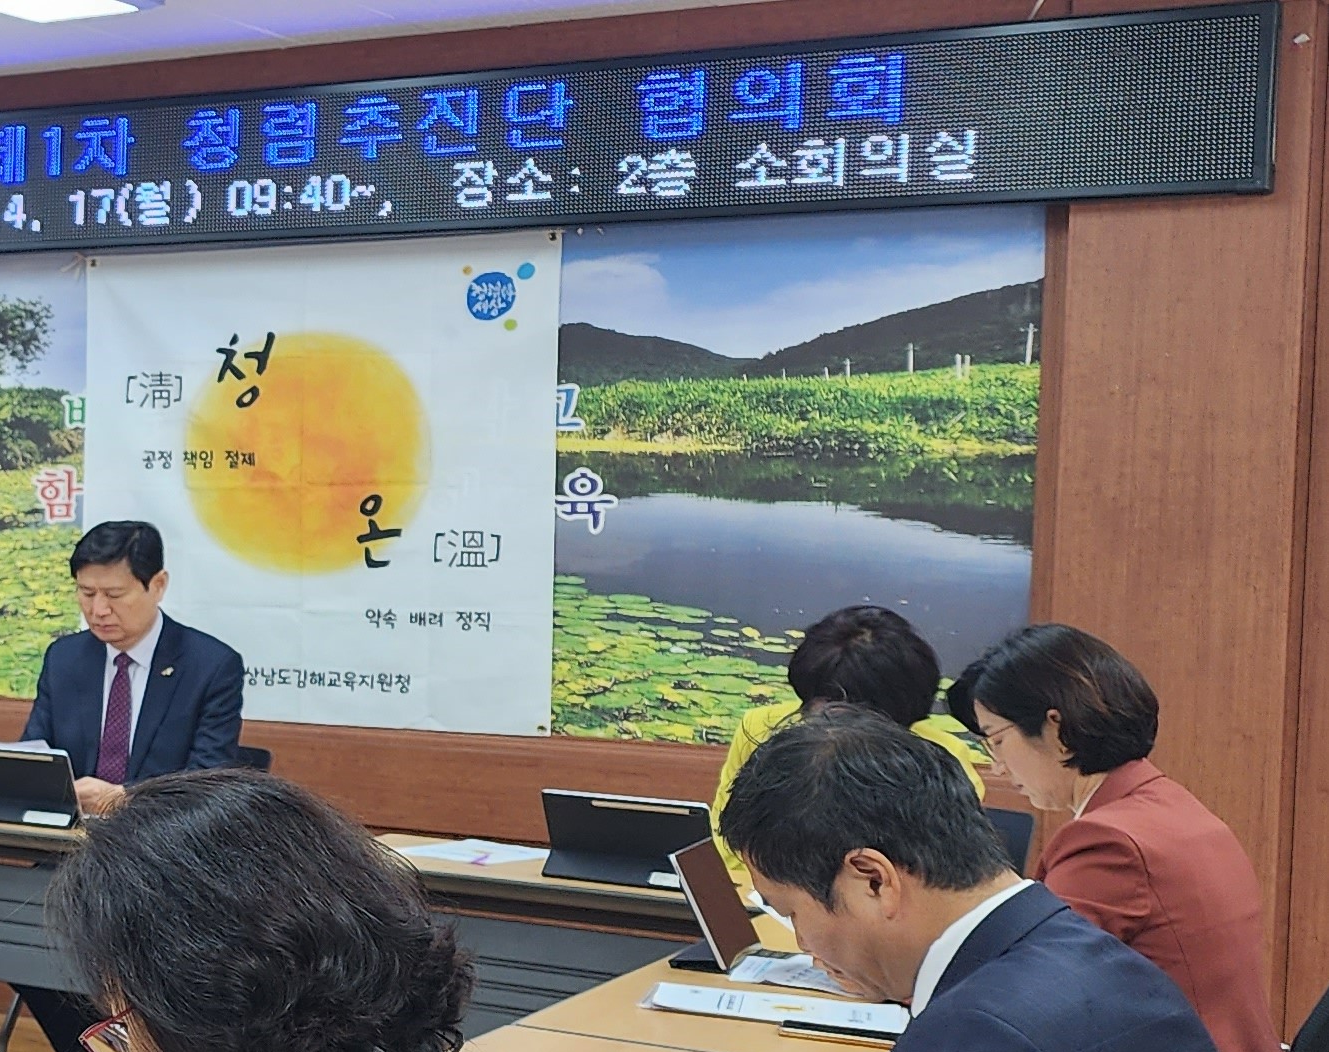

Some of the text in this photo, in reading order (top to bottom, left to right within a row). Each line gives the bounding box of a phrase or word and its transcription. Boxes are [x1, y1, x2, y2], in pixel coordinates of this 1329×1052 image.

[181, 80, 574, 172] 청렴추진단
[636, 53, 907, 142] 협의회
[2, 193, 42, 232] 4.
[616, 148, 697, 197] 2층
[733, 129, 977, 188] 소회의실
[215, 331, 276, 409] 청
[142, 450, 256, 470] 공정 책임 절제
[356, 494, 403, 569] 온
[365, 609, 492, 631] 약속 배려 정직
[242, 667, 412, 694] 상남도김해교육지원청
